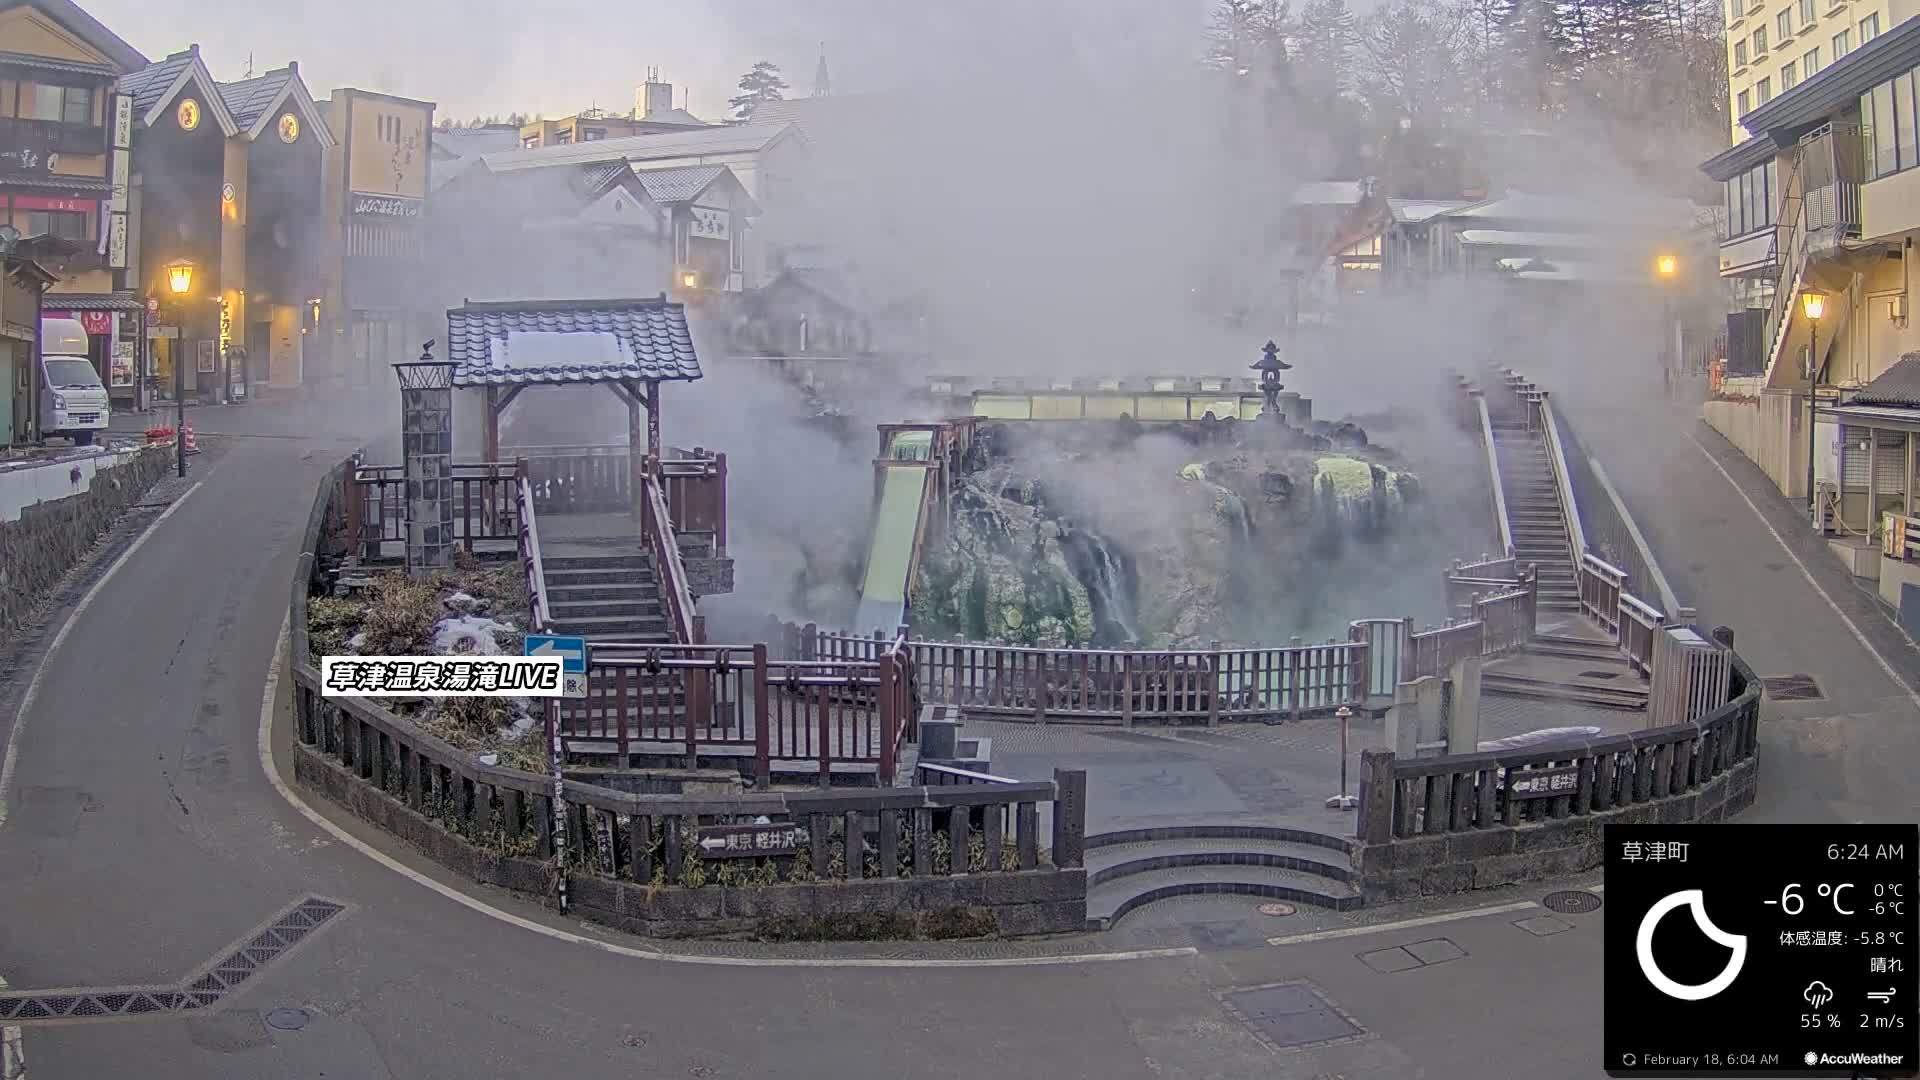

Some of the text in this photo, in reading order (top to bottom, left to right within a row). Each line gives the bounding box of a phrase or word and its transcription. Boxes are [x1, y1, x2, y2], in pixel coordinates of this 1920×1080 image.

[725, 830, 797, 851] 東京 軽井沢
